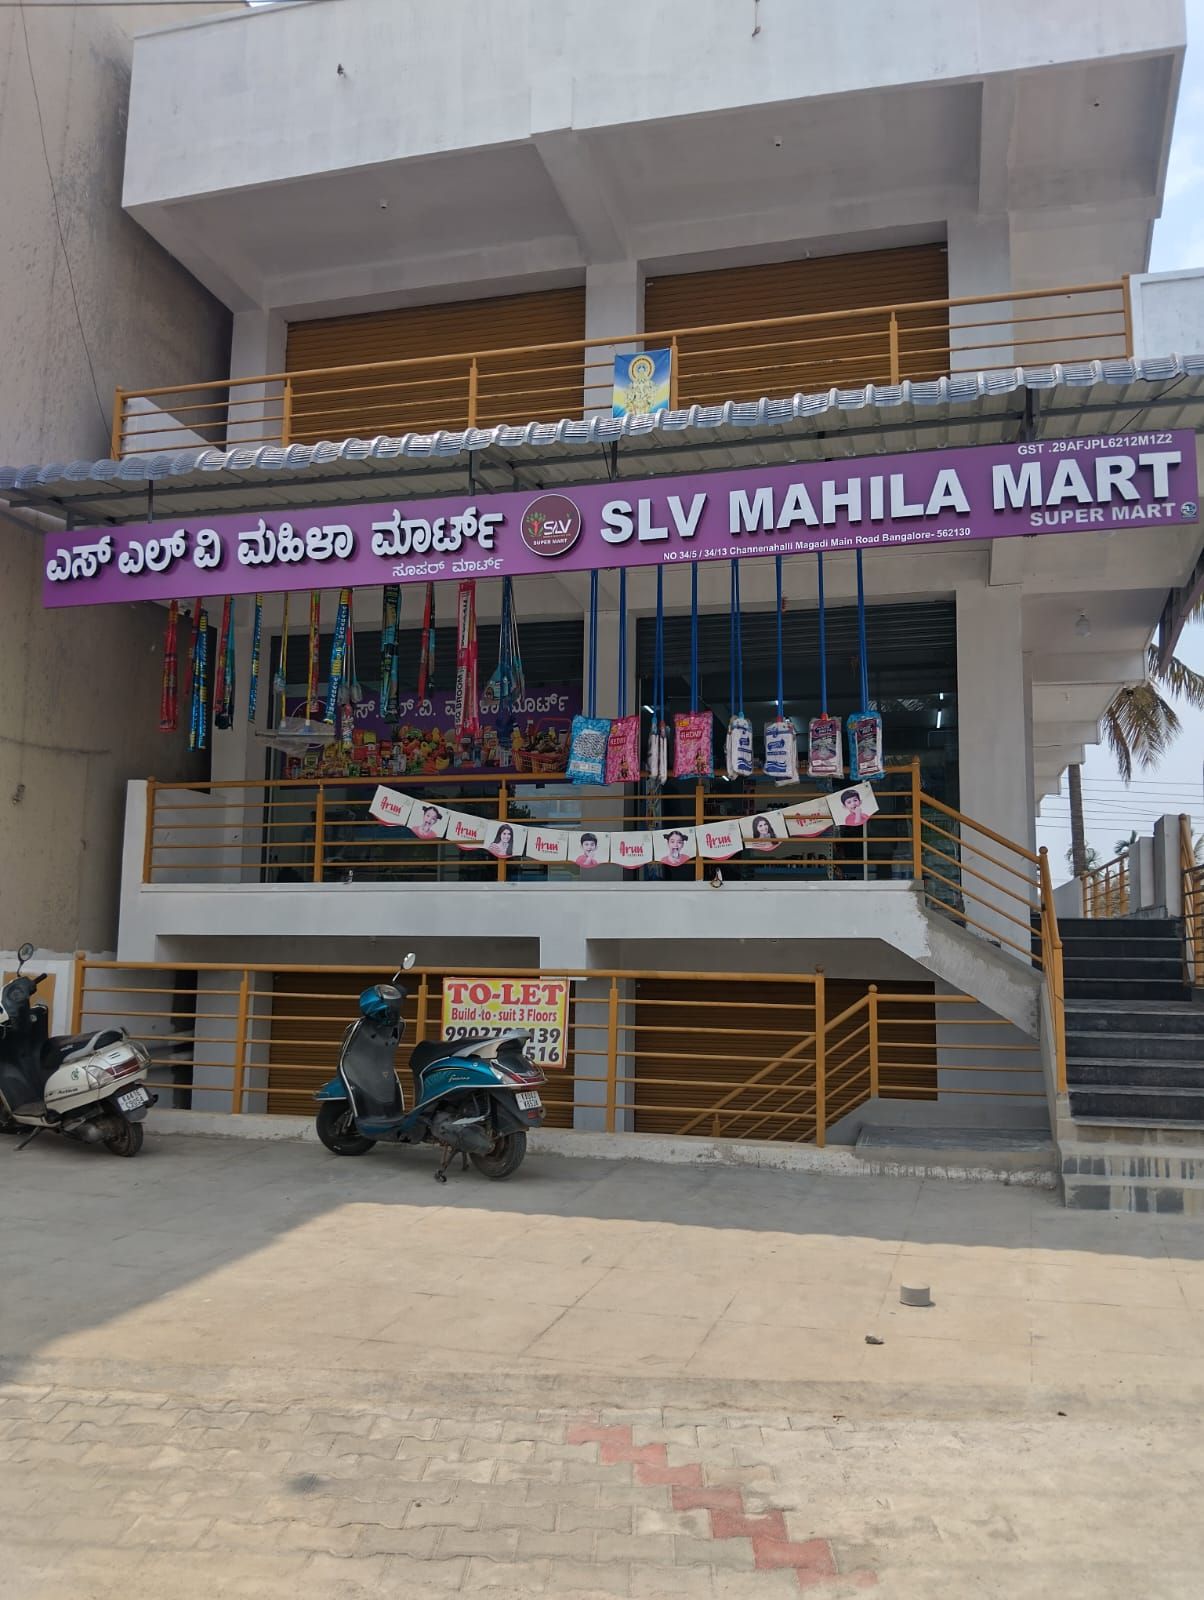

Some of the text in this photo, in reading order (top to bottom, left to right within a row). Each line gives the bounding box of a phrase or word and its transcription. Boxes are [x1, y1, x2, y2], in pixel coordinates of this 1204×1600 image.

[1017, 443, 1045, 456] GST
[600, 451, 1182, 544] SLV MAHILA MART
[1030, 502, 1177, 527] SUPER MART
[543, 519, 572, 536] SLV
[46, 535, 112, 582] ಎಸ್
[118, 529, 187, 574] ಎಲ್
[193, 528, 222, 568] ವಿ
[237, 518, 355, 565] ಮಹಿಳಾ
[663, 551, 677, 561] NO
[704, 547, 728, 558] 34/13
[729, 542, 793, 556] Channenahalli
[795, 539, 829, 551] Magadi
[830, 537, 853, 547] Main
[855, 534, 880, 544] Road
[936, 527, 971, 538] 562130
[455, 821, 477, 838] Arun
[535, 836, 559, 852] Arun
[619, 841, 643, 857] Arun
[705, 833, 731, 849] Arun
[447, 983, 564, 1006] TO-LET
[451, 1007, 476, 1021] Build
[498, 1008, 517, 1021] suit
[519, 1009, 525, 1022] 3
[527, 1008, 558, 1022] Floors
